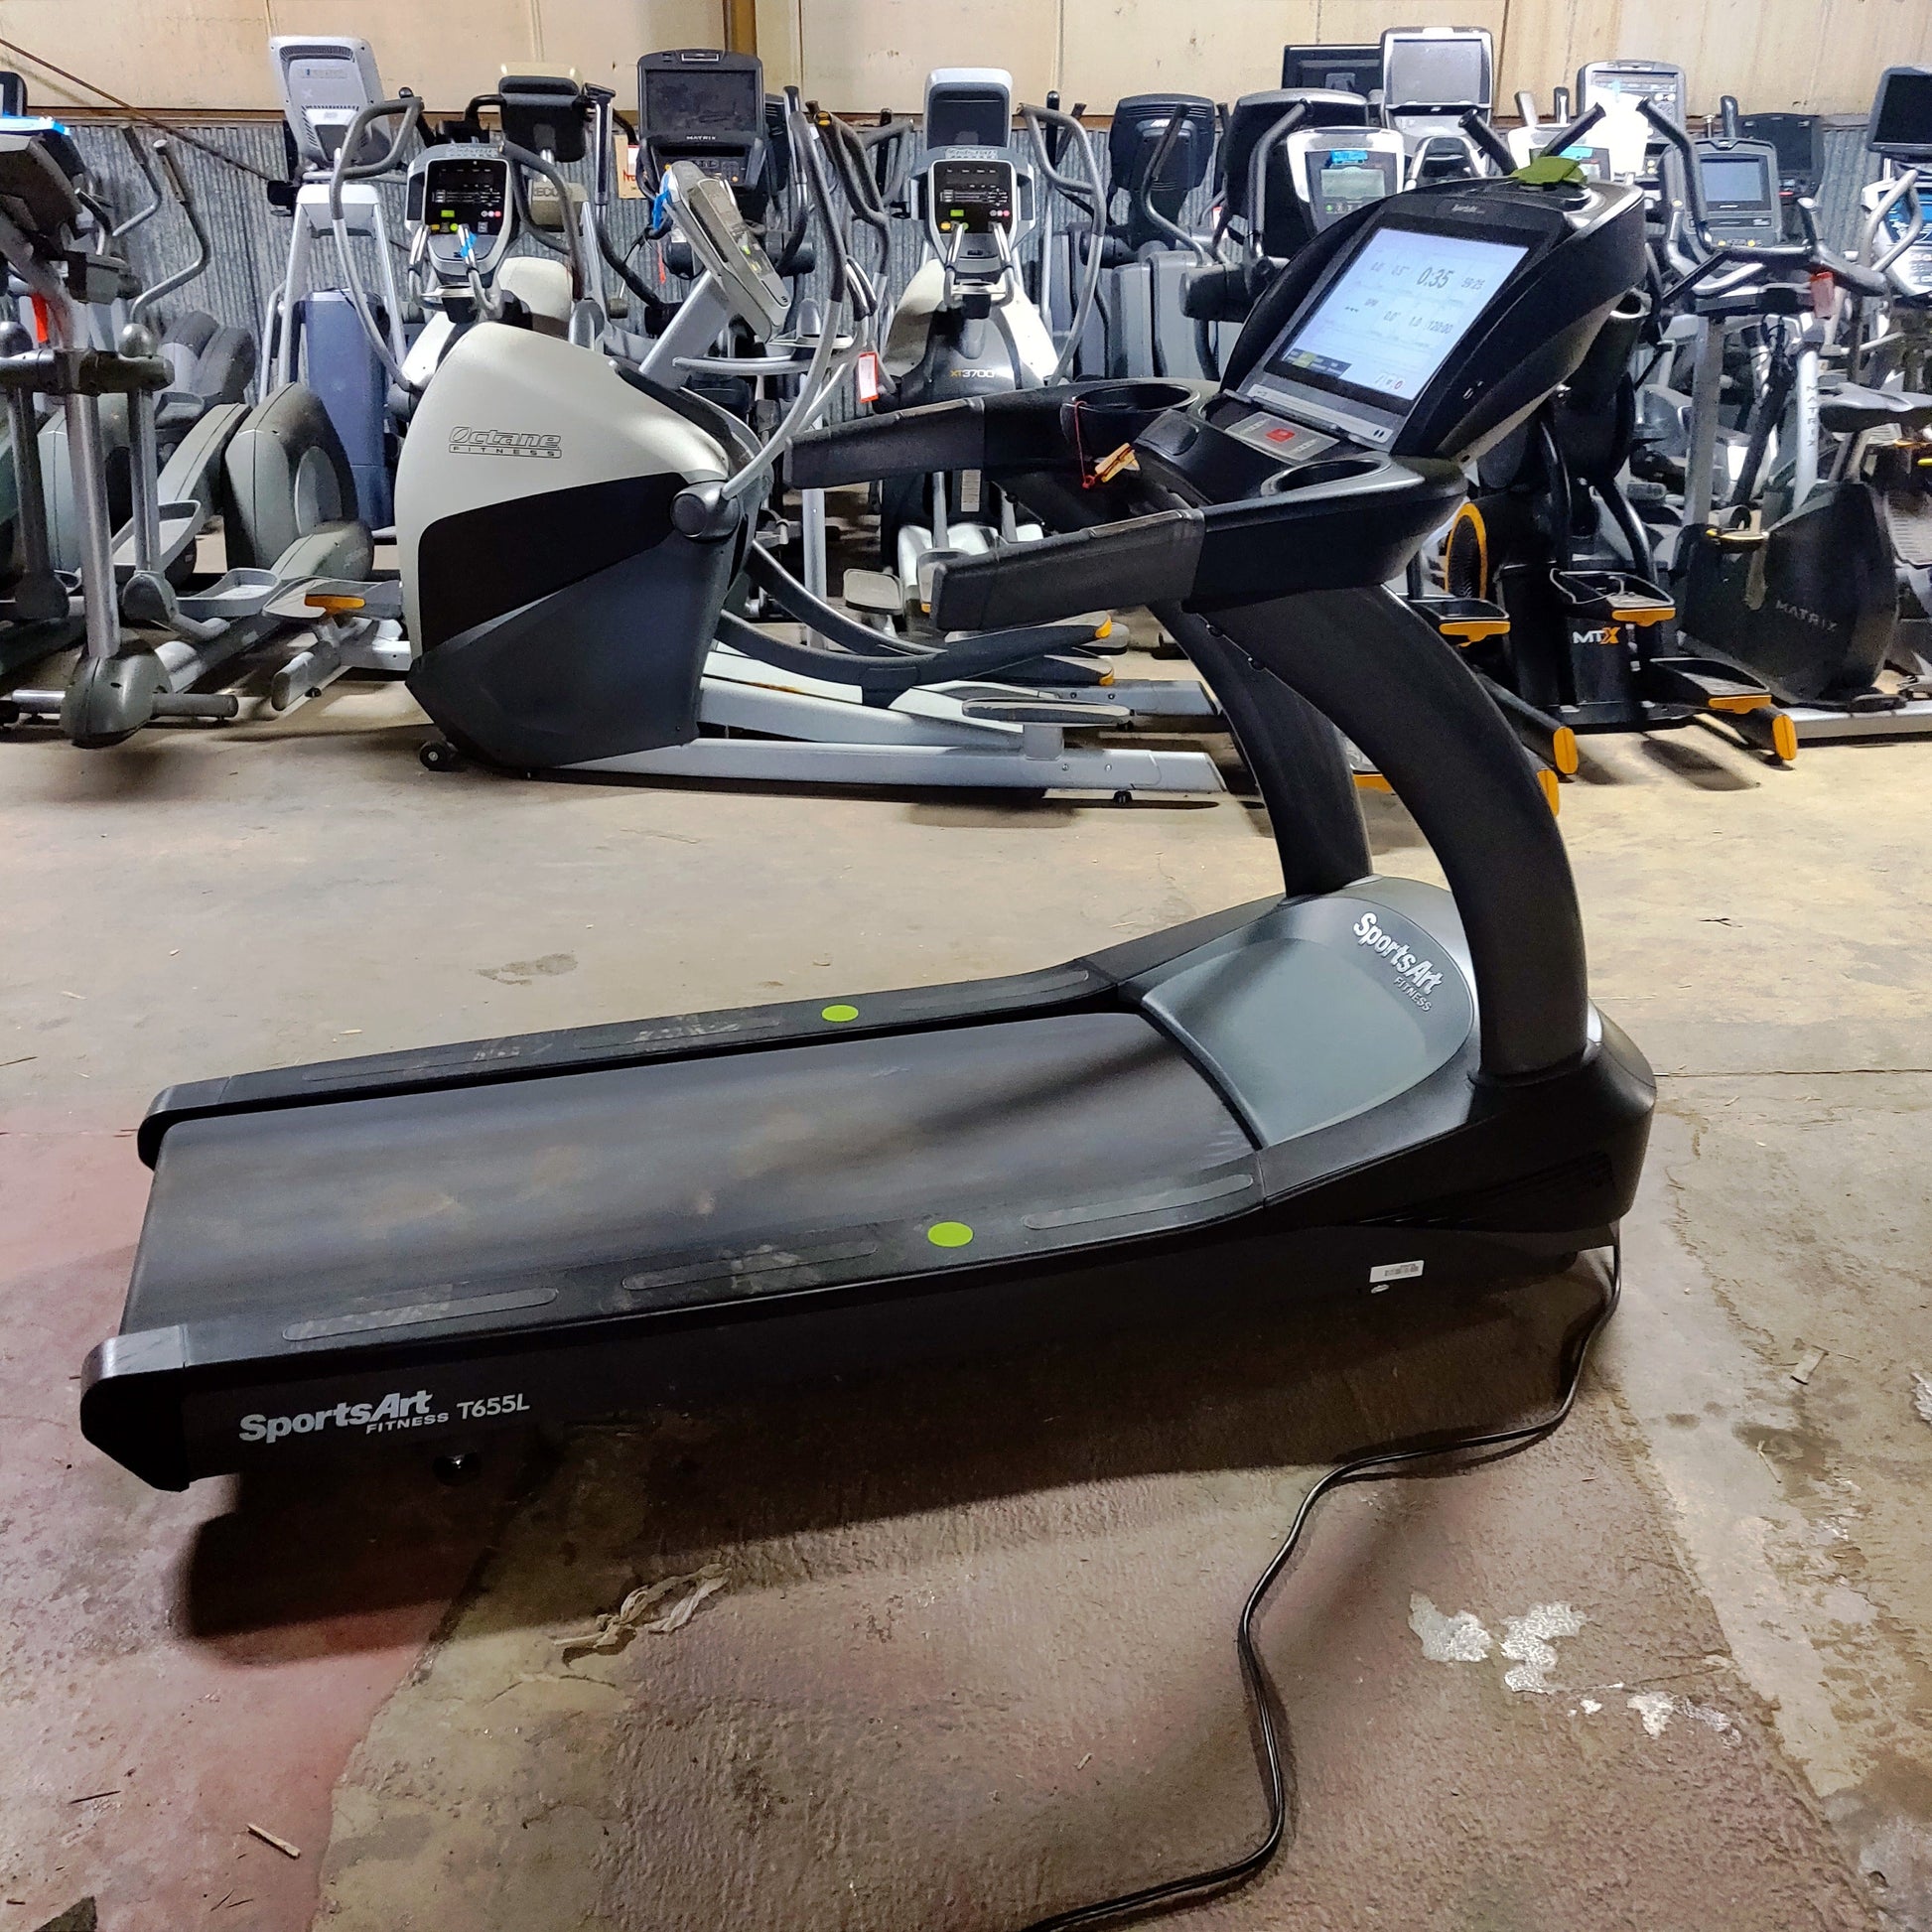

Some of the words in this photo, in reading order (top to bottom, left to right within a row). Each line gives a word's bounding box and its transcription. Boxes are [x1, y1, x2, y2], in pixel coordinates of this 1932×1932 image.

[1416, 266, 1454, 289] 0:35
[449, 426, 562, 450] Octane
[453, 445, 556, 458] FITNESS
[1775, 600, 1838, 632] MATRIX
[1572, 626, 1621, 645] MTX
[1352, 911, 1444, 995] SportsArt
[1393, 976, 1432, 1011] FITNESS
[238, 1389, 434, 1444] SportsArt
[365, 1412, 449, 1435] FITNESS
[456, 1393, 530, 1420] T655L
